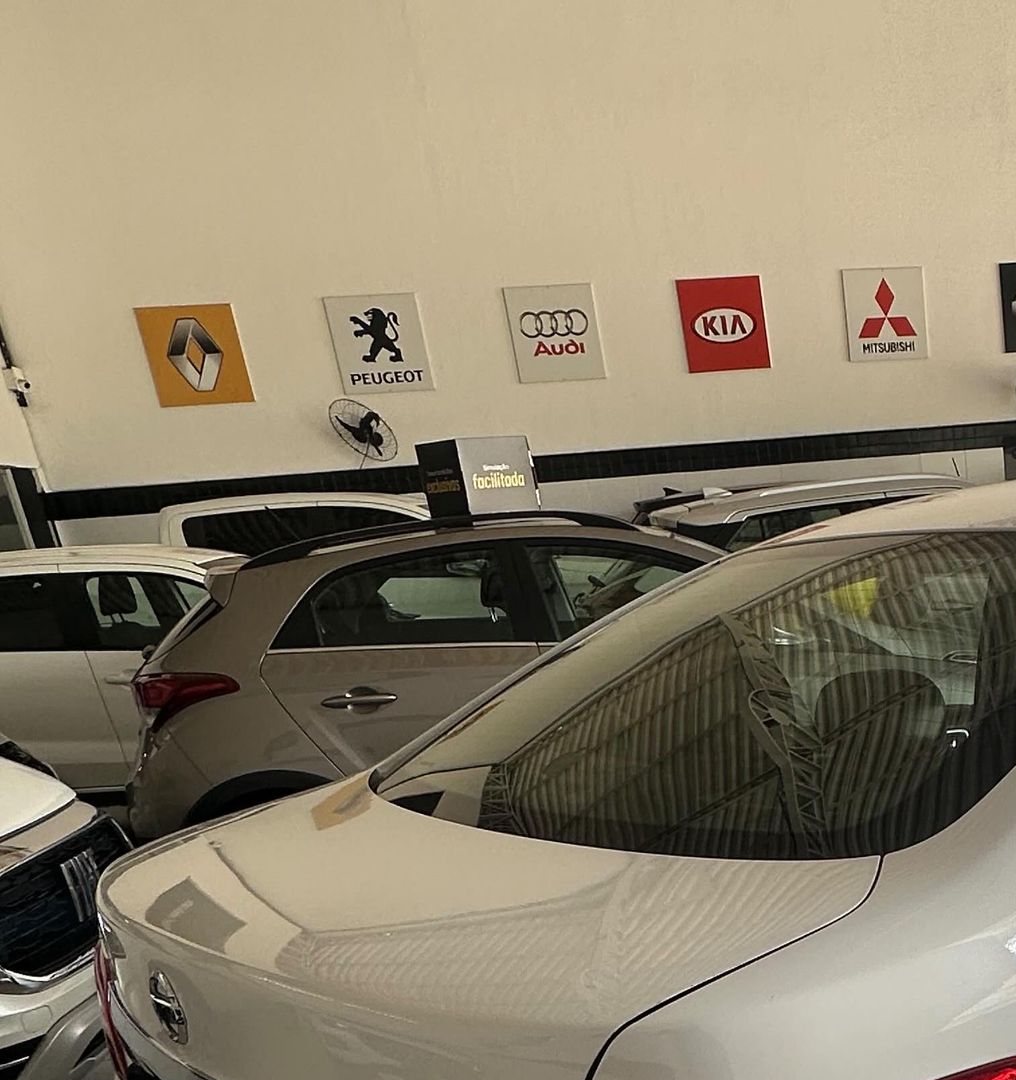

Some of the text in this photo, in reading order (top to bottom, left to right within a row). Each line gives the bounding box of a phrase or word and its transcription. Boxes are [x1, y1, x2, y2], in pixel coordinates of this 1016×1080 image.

[701, 313, 749, 337] KIA
[533, 338, 586, 357] Audi
[861, 340, 916, 354] MITSUBISHI
[350, 369, 424, 386] PEUGEOT
[472, 471, 526, 489] facilitada
